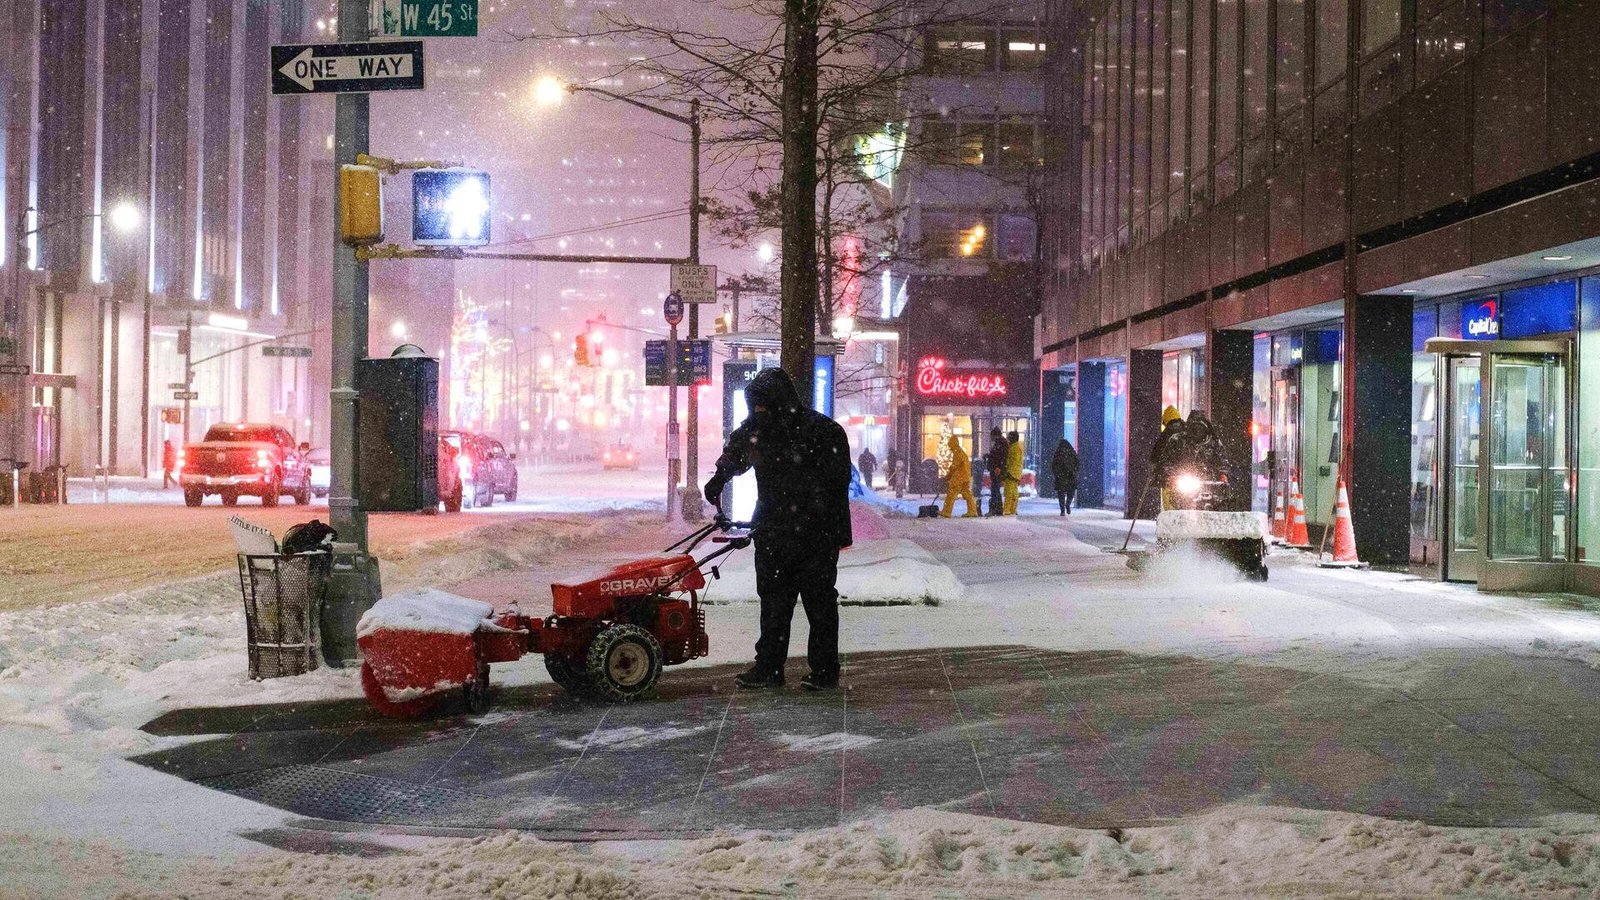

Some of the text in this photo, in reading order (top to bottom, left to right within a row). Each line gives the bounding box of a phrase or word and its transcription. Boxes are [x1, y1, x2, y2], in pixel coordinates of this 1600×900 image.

[403, 3, 473, 31] W 45 St
[295, 57, 403, 78] ONE WAY
[679, 267, 708, 276] BUSES
[682, 280, 704, 289] ONLY
[918, 365, 1007, 397] Chick-fil-A
[230, 515, 251, 531] LITTLE
